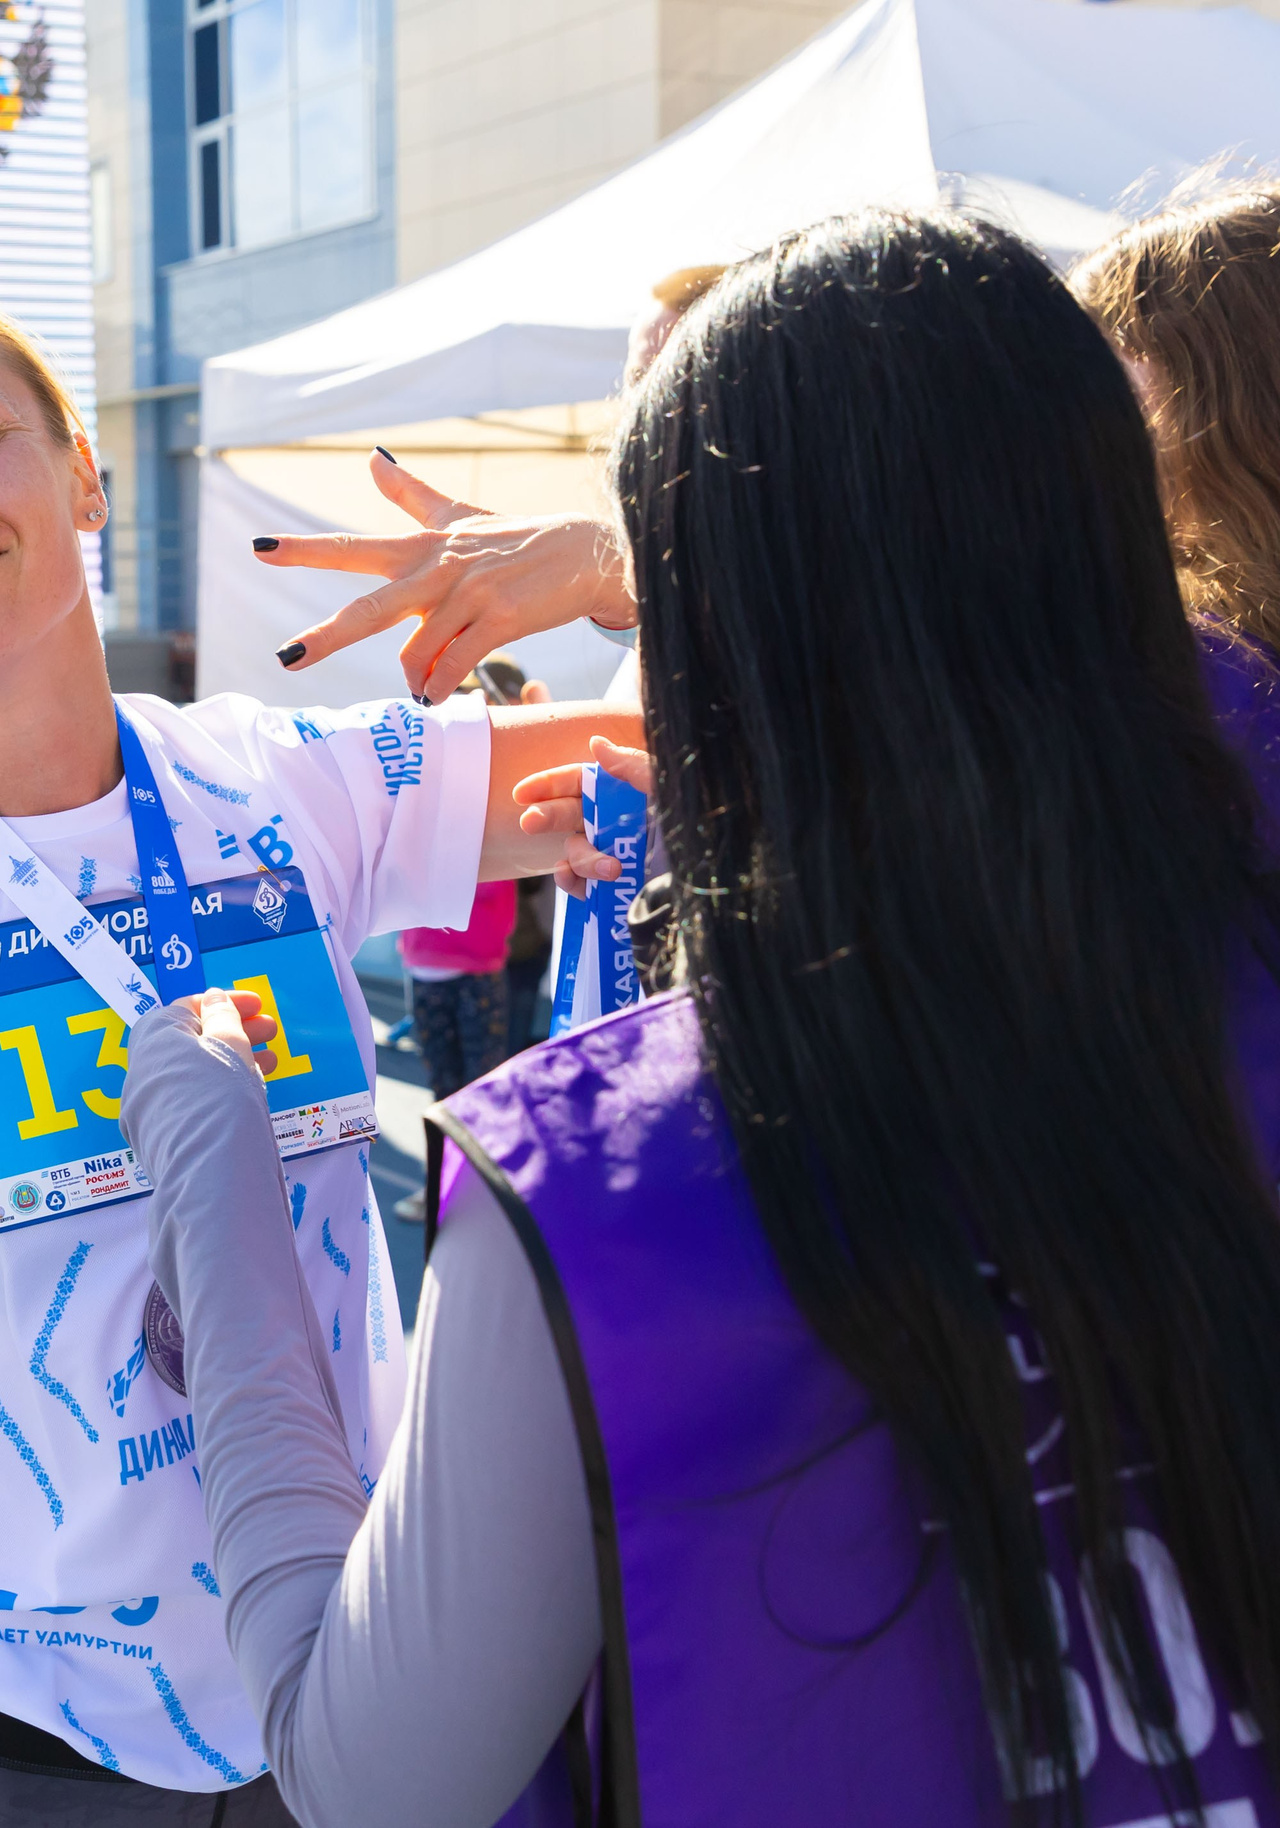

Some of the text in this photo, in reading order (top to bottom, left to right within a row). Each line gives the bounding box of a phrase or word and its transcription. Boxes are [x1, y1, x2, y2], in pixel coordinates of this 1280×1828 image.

[614, 951, 635, 1010] КАЯ
[275, 1128, 304, 1140] YAMAGUCHI
[50, 1168, 71, 1181] ВТБ
[90, 1180, 130, 1195] РОНДАМИТ
[35, 1630, 153, 1660] УДМУРТИИ
